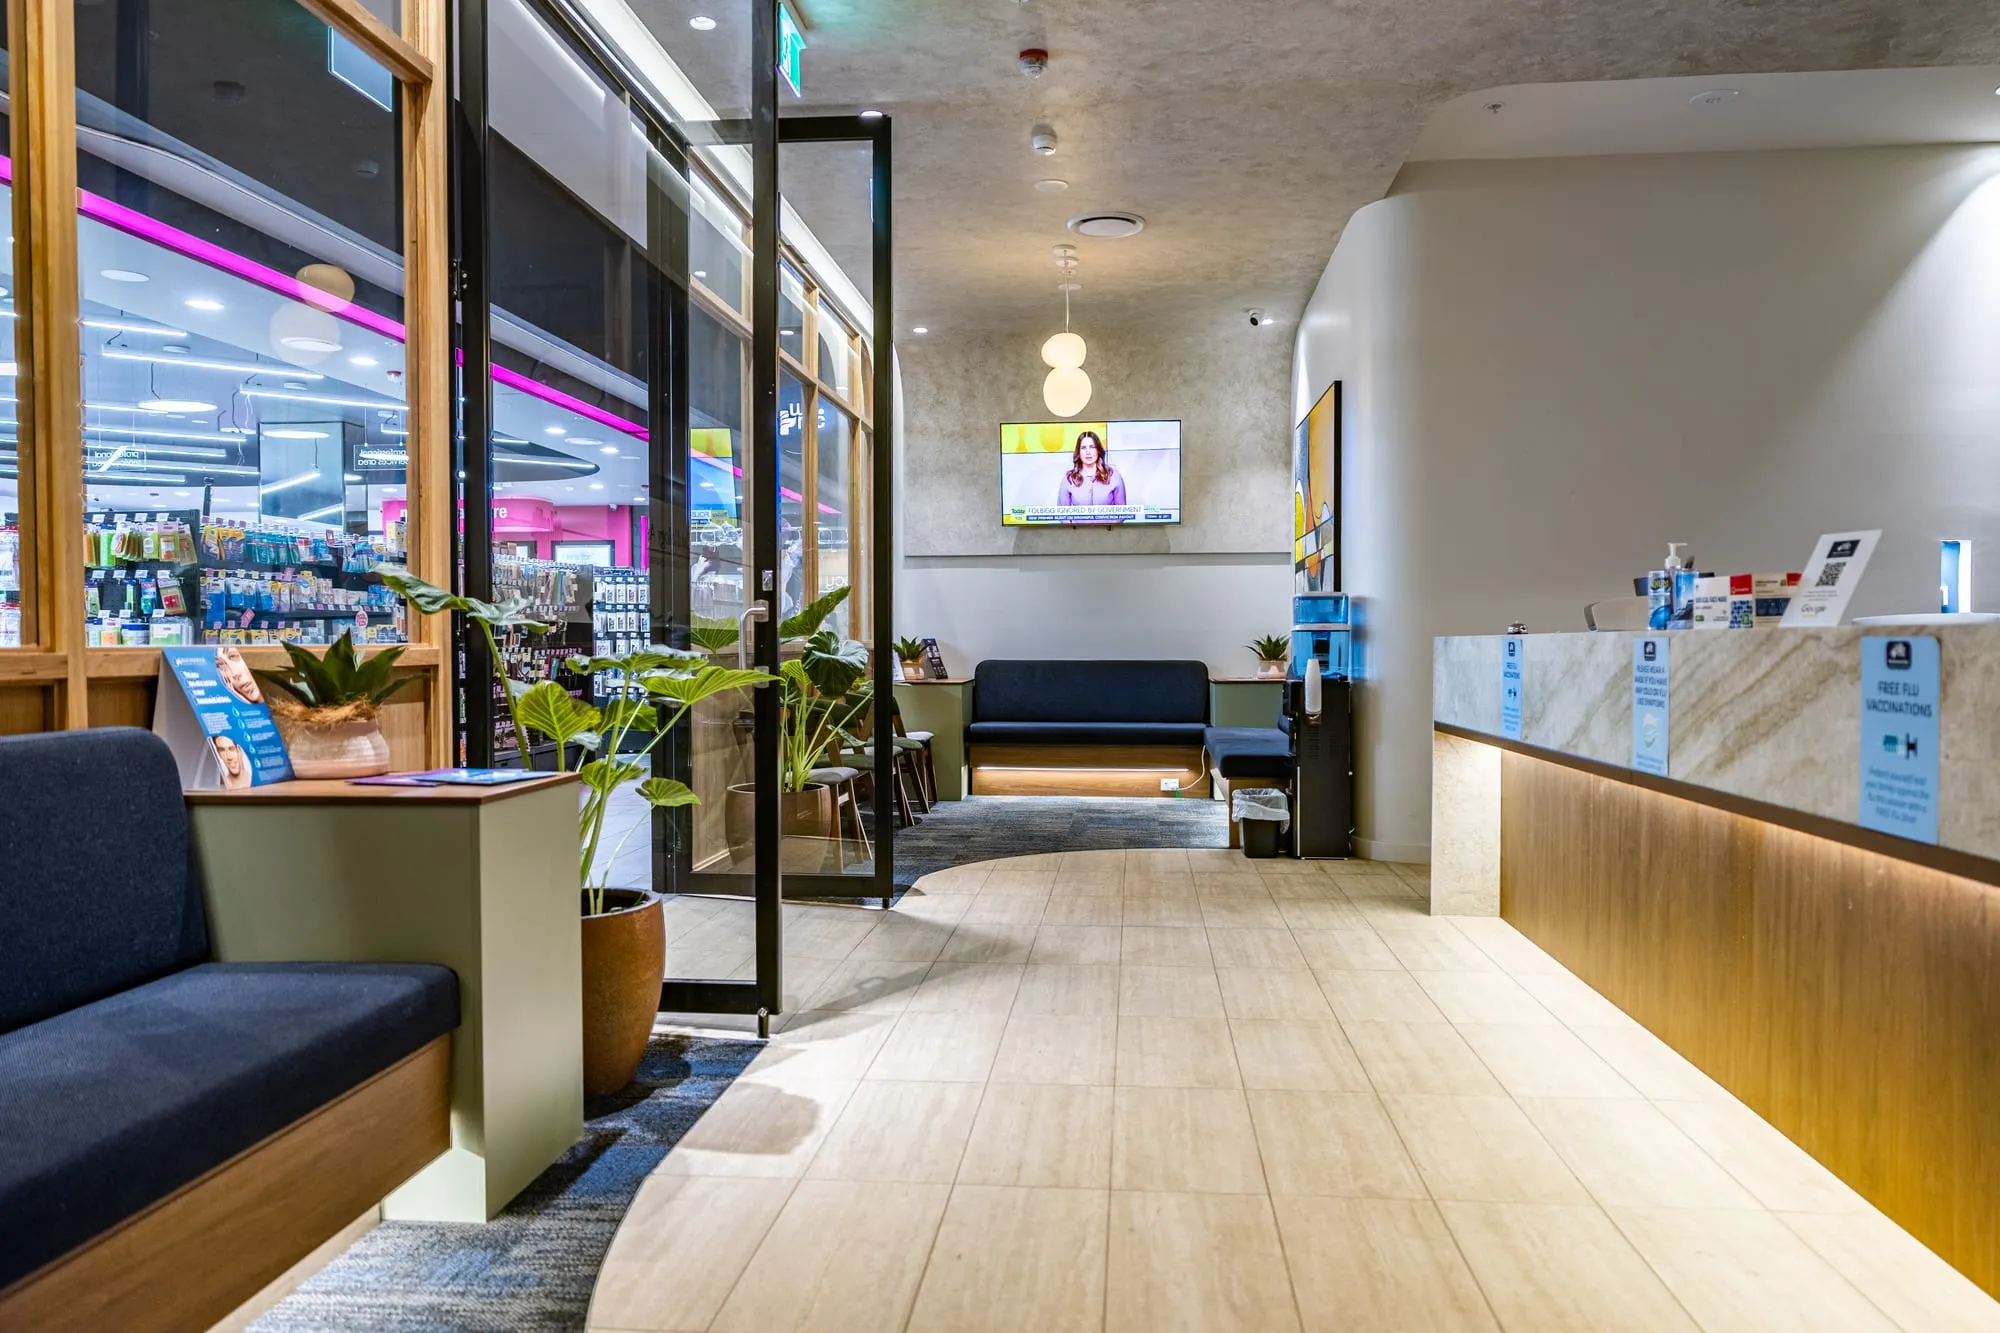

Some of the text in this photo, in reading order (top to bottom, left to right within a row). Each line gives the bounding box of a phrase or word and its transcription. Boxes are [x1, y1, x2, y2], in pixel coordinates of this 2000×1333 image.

[1878, 681, 1919, 697] FREE FLU
[1866, 698, 1932, 717] VACCINATIONS
